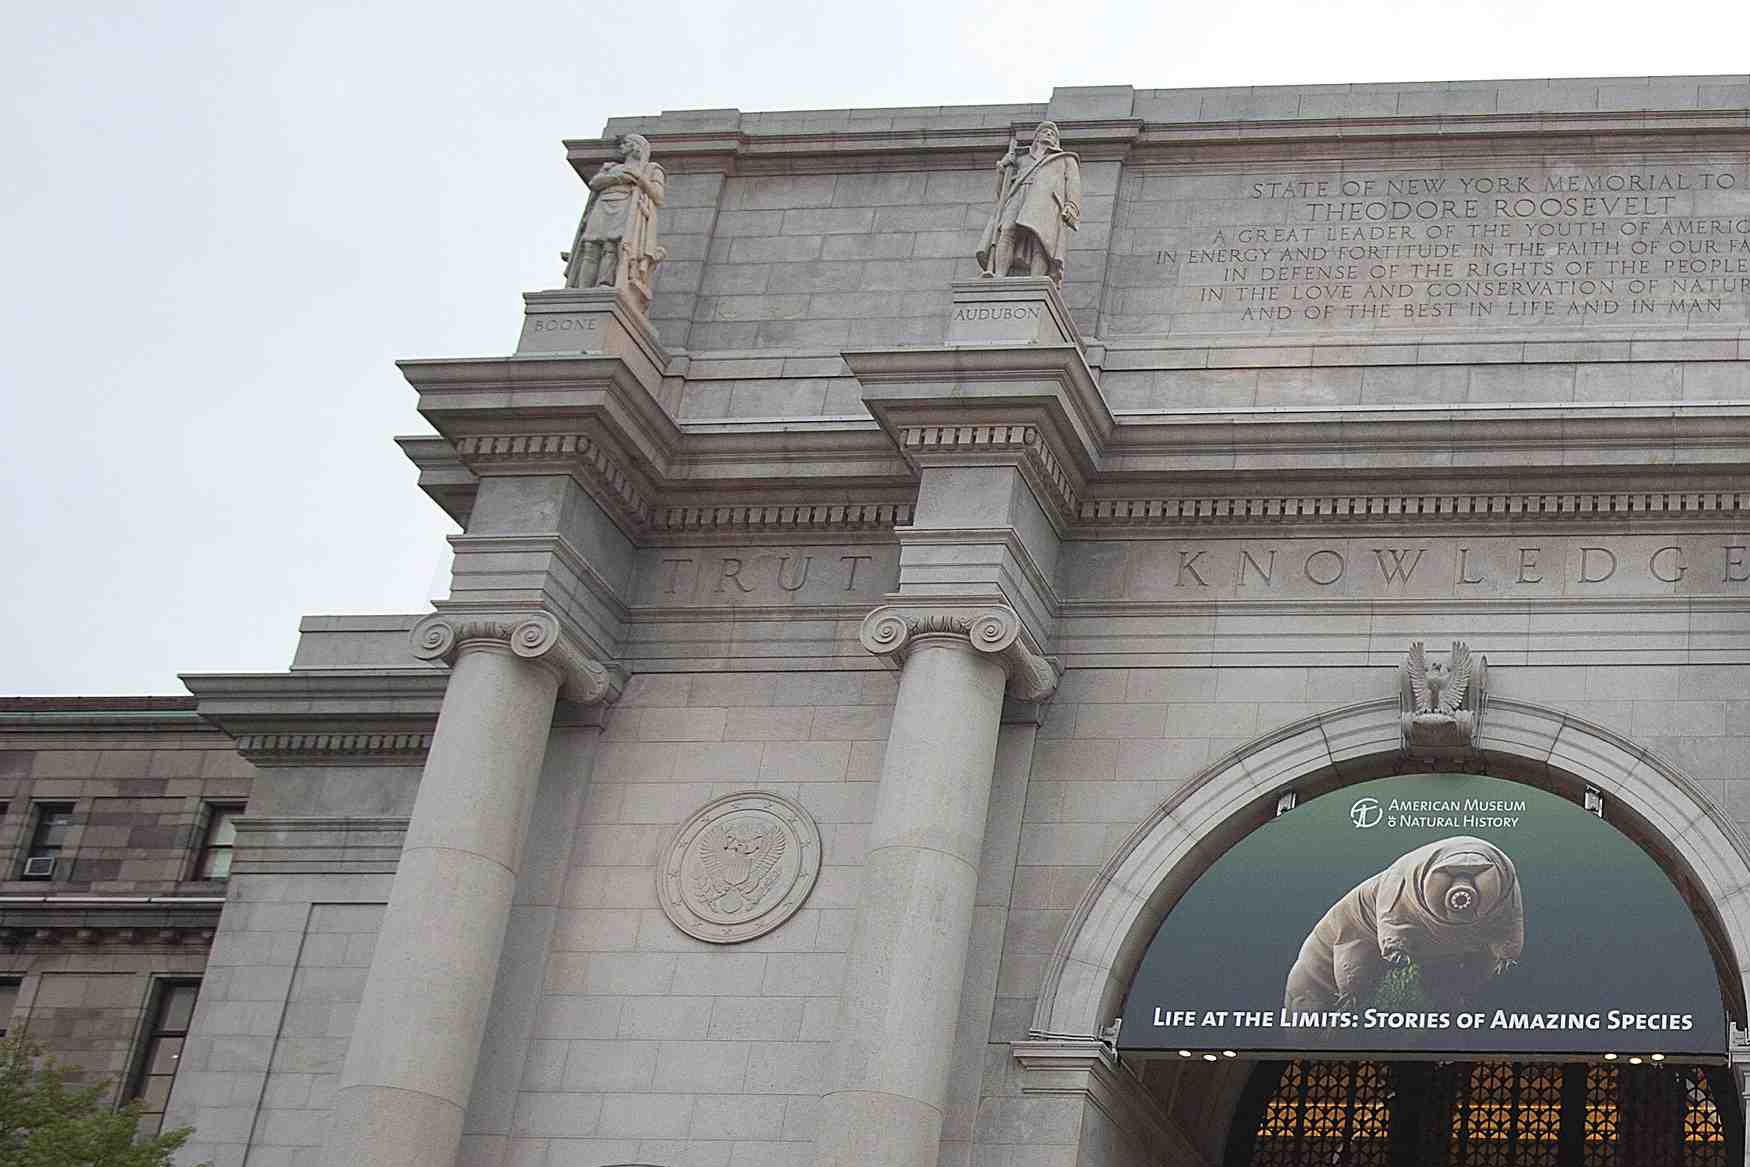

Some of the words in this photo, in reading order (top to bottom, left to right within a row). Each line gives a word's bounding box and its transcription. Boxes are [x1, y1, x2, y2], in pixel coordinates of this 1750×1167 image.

[1253, 181, 1329, 199] STATE
[1342, 180, 1376, 197] OF
[1386, 178, 1447, 195] NEW
[1461, 176, 1532, 194] YORK
[1544, 174, 1692, 193] MEMORIAL
[1701, 173, 1736, 190] TO
[1305, 199, 1479, 221] THEODORE
[1494, 196, 1676, 217] ROOSEVELT
[1214, 229, 1226, 244] A
[1238, 228, 1315, 243] GREAT
[1327, 225, 1416, 241] LEADER
[1425, 224, 1456, 239] OF
[1468, 223, 1511, 238] THE
[1525, 221, 1606, 237] YOUTH
[1620, 221, 1651, 236] OF
[1156, 250, 1177, 264] IN
[1188, 249, 1271, 264] ENERGY
[1280, 246, 1327, 261] AND
[1339, 243, 1462, 260] FORTITUDE
[1472, 243, 1494, 257] IN
[1507, 242, 1546, 257] THE
[1557, 240, 1620, 255] FAITH
[1631, 240, 1660, 255] OF
[1669, 239, 1720, 254] OUR
[1224, 268, 1247, 282] IN
[1261, 265, 1358, 281] DEFENSE
[1370, 264, 1399, 279] OF
[1411, 262, 1454, 278] THE
[1467, 260, 1554, 277] RIGHTS
[1565, 260, 1596, 275] OF
[1608, 259, 1649, 274] THE
[1664, 258, 1749, 274] PEOPLE
[1200, 287, 1224, 302] IN
[1237, 286, 1279, 301] THE
[1291, 284, 1353, 300] LOVE
[1363, 283, 1414, 299] AND
[1426, 279, 1617, 299] CONSERVATION
[1628, 279, 1659, 294] OF
[955, 307, 1040, 321] AUDUBON
[1240, 305, 1292, 321] AND
[1304, 304, 1335, 320] OF
[1348, 303, 1391, 318] THE
[1403, 302, 1457, 317] BEST
[1469, 301, 1491, 316] IN
[1507, 300, 1555, 316] LIFE
[1567, 299, 1619, 314] AND
[1632, 299, 1655, 314] IN
[1668, 298, 1722, 313] MAN
[535, 318, 597, 333] BOONE
[663, 555, 873, 594] TRUT
[1153, 1007, 1196, 1027] LIFE
[1201, 1011, 1228, 1027] AT
[1233, 1011, 1274, 1027] THE
[1279, 1007, 1358, 1028] LIMITS:
[1363, 1008, 1451, 1029] STORIES
[1456, 1012, 1486, 1029] OF
[1490, 1009, 1601, 1030] AMAZING
[1607, 1010, 1694, 1031] SPECIES
